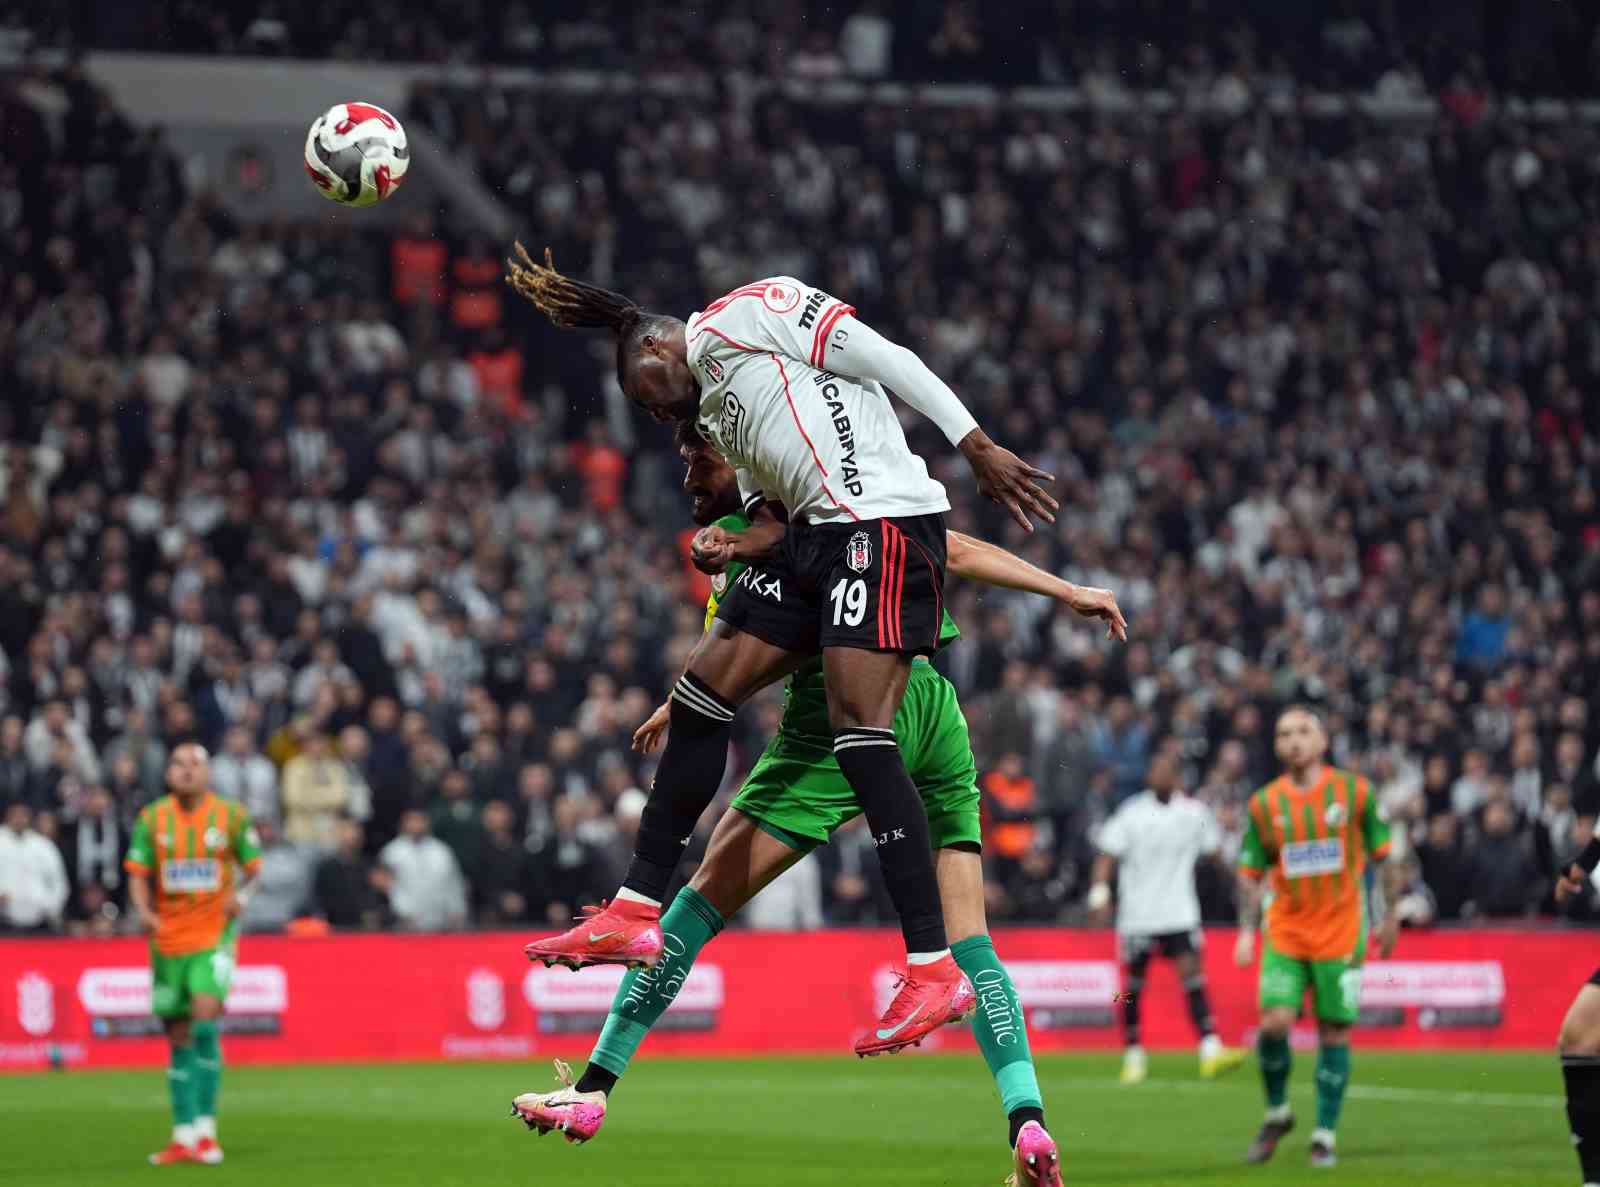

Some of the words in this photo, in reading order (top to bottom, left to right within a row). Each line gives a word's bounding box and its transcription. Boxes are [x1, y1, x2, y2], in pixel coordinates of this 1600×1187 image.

[799, 292, 829, 330] mis
[832, 330, 848, 352] 19
[735, 566, 781, 602] RKA
[830, 578, 868, 627] 19
[974, 969, 1018, 1048] Organic
